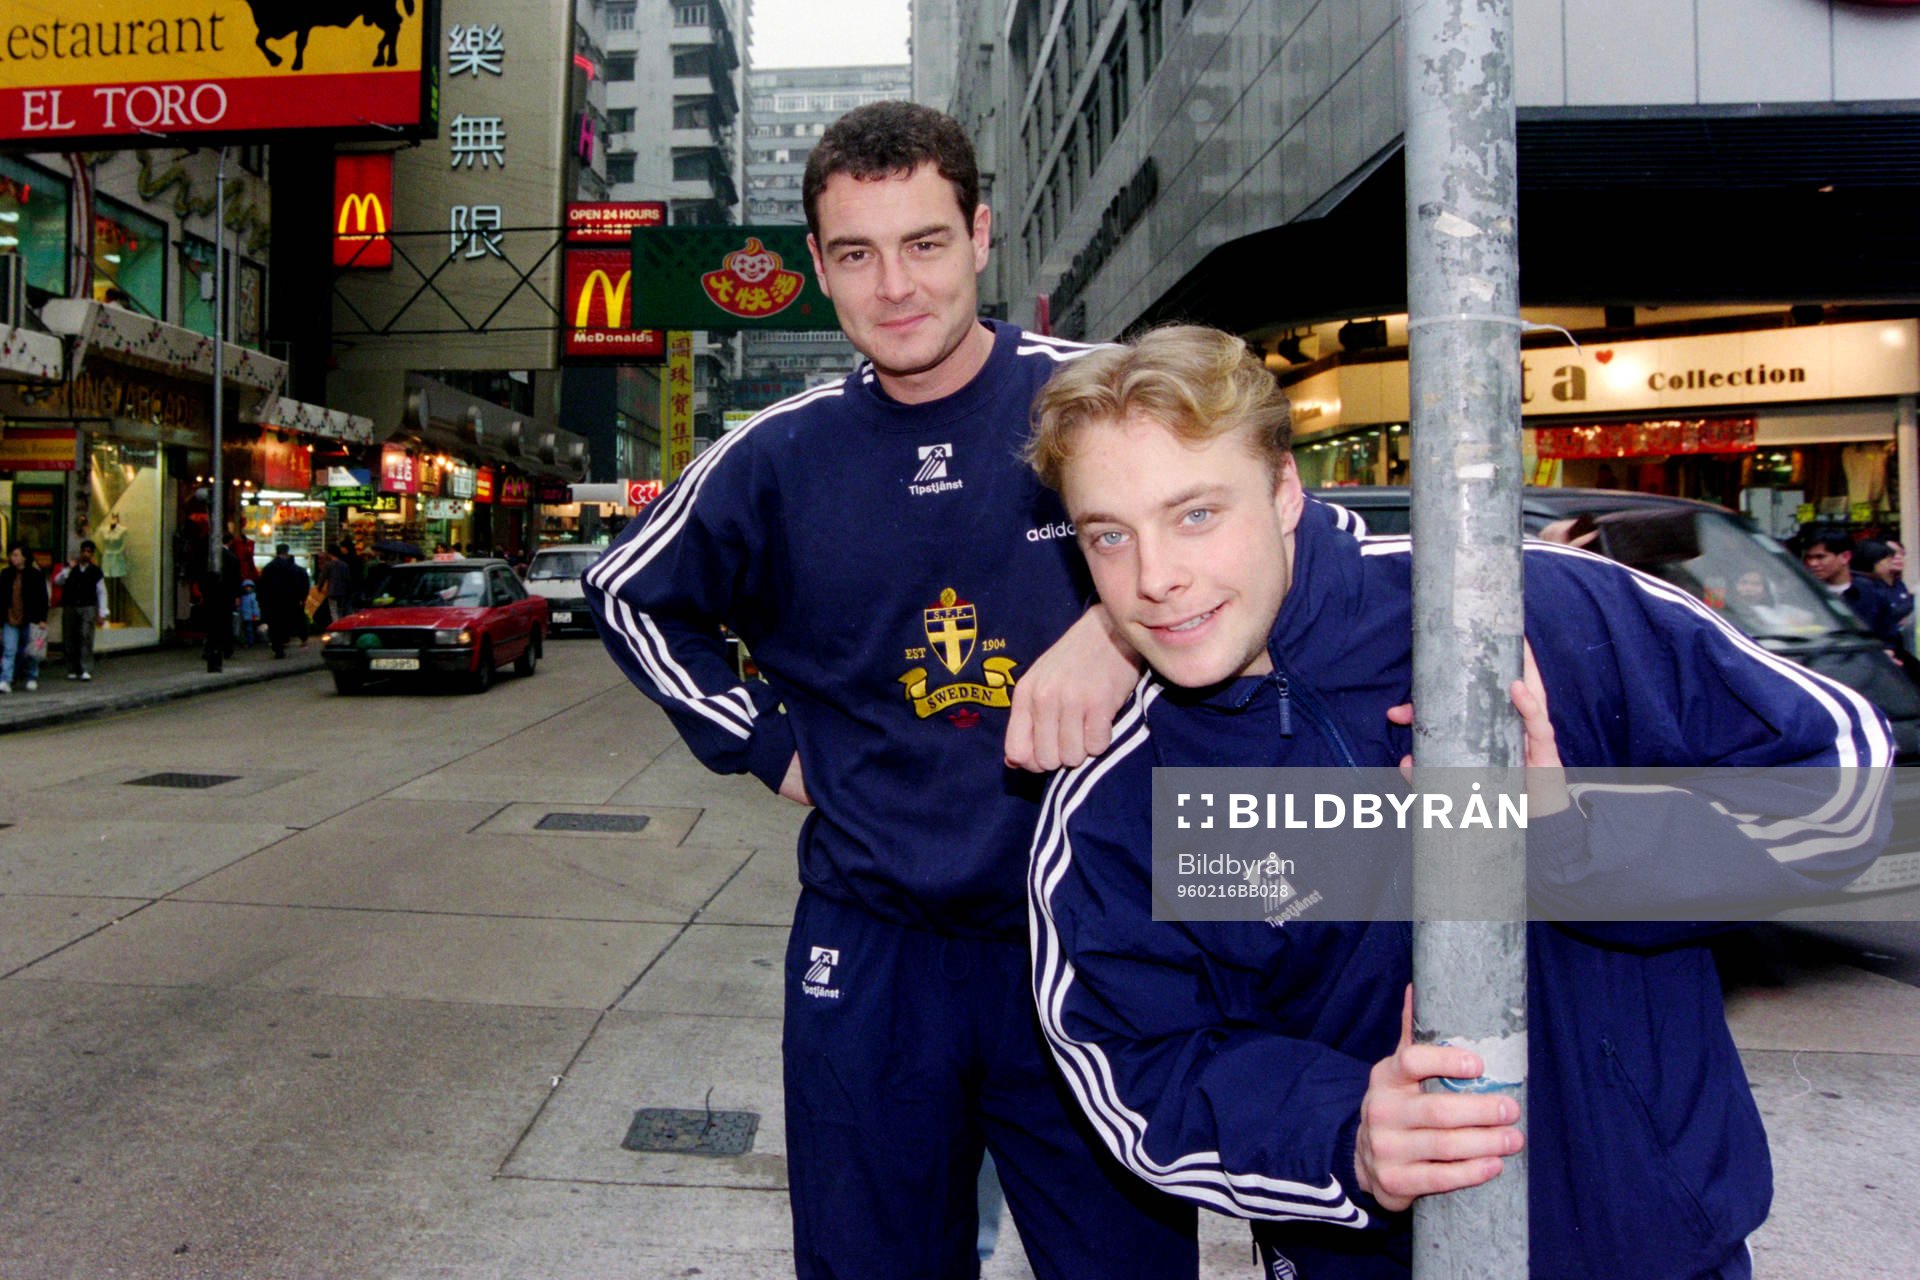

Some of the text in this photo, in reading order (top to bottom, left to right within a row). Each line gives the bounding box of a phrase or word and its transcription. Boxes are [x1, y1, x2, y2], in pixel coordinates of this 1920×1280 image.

[0, 13, 225, 62] estaurant
[22, 83, 227, 131] EL TORO
[448, 24, 505, 260] 樂無限
[570, 209, 660, 220] OPEN 24 HOURS
[709, 273, 797, 311] 大快活
[1648, 364, 1806, 391] Collection
[908, 478, 964, 496] Tipstjänst
[905, 638, 1006, 660] EST 1904
[927, 684, 993, 710] SWEDEN
